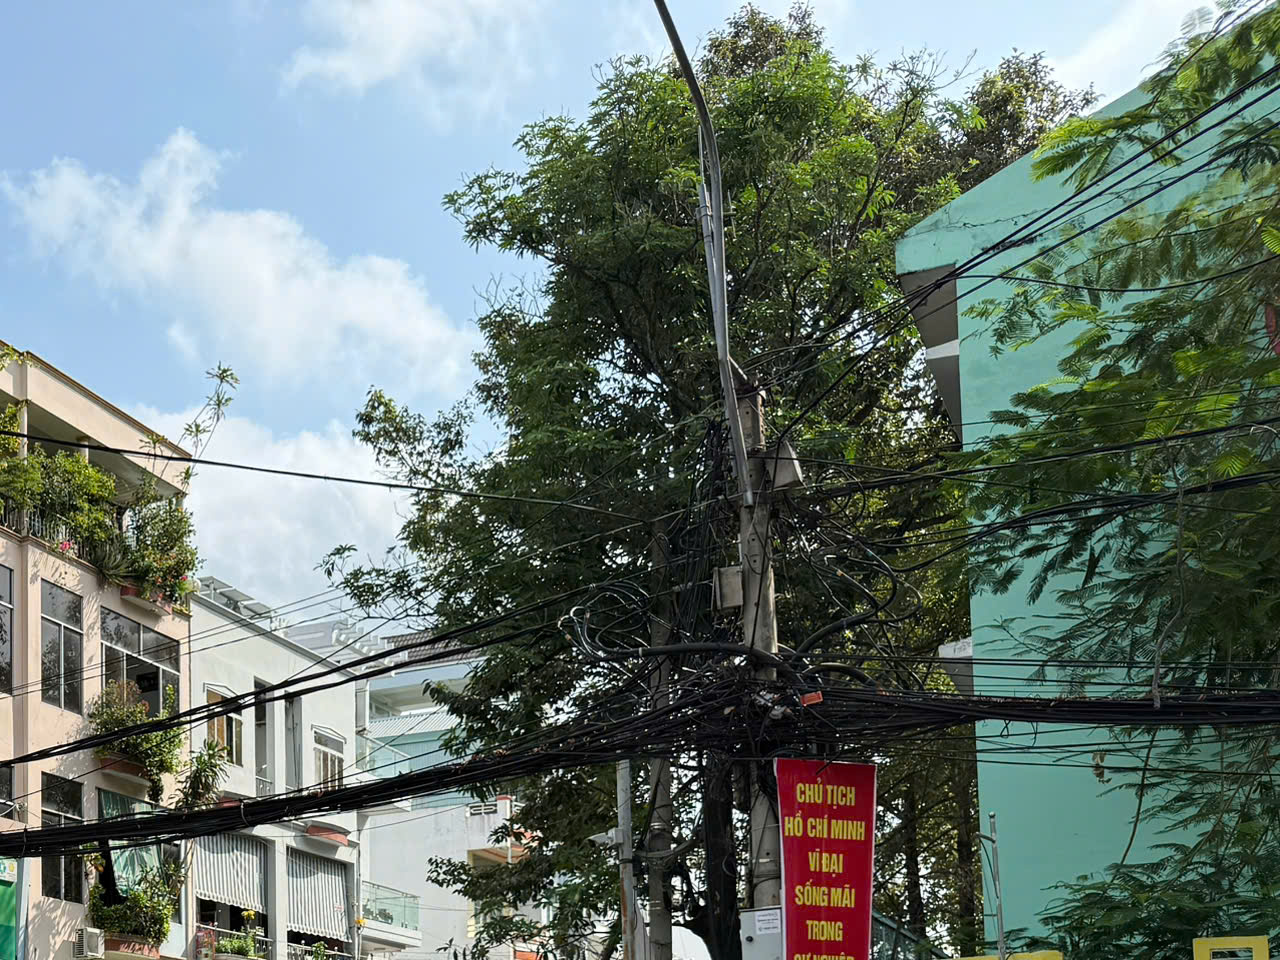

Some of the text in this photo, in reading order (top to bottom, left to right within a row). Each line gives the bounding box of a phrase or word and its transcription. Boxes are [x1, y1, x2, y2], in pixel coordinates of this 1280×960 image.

[798, 777, 856, 810] CHỦ TỊCH
[784, 810, 866, 840] HỒ CHÍ MINH
[822, 856, 844, 879] ĐẠI
[795, 879, 856, 908] SỐNG MÃI
[807, 920, 845, 941] TRONG
